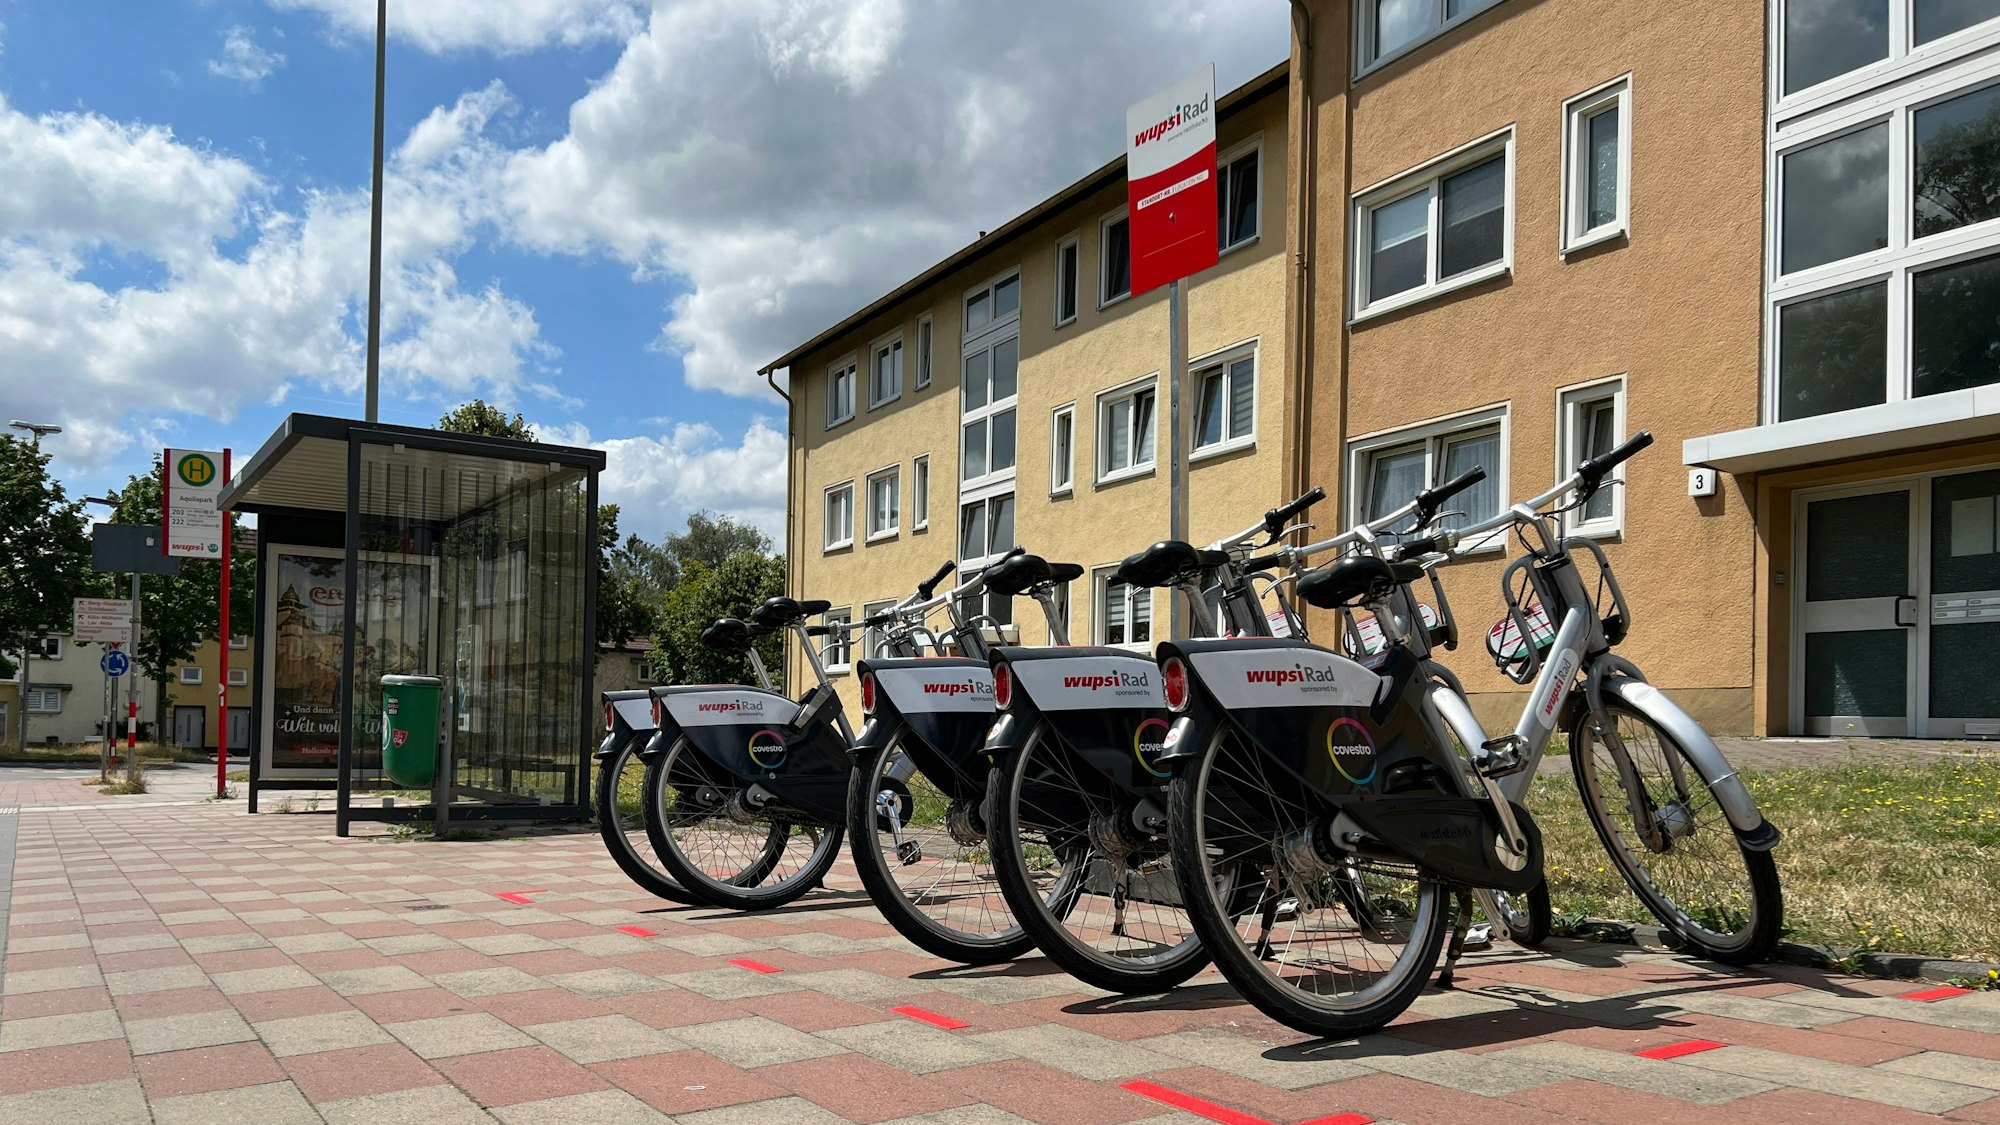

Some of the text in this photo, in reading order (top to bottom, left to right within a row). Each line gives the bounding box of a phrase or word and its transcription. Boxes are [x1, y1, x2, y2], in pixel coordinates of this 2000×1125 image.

[189, 460, 205, 480] H
[1695, 474, 1704, 490] 3
[172, 508, 185, 516] 203
[172, 518, 185, 526] 222
[172, 542, 204, 552] wupsi
[1115, 689, 1151, 697] sponsored by
[1300, 685, 1338, 693] sponsored by
[293, 705, 311, 714] Und
[312, 706, 334, 714] dann
[276, 716, 316, 734] Welt
[752, 745, 784, 753] covestro
[1139, 742, 1164, 752] cove
[1332, 743, 1372, 756] covestro
